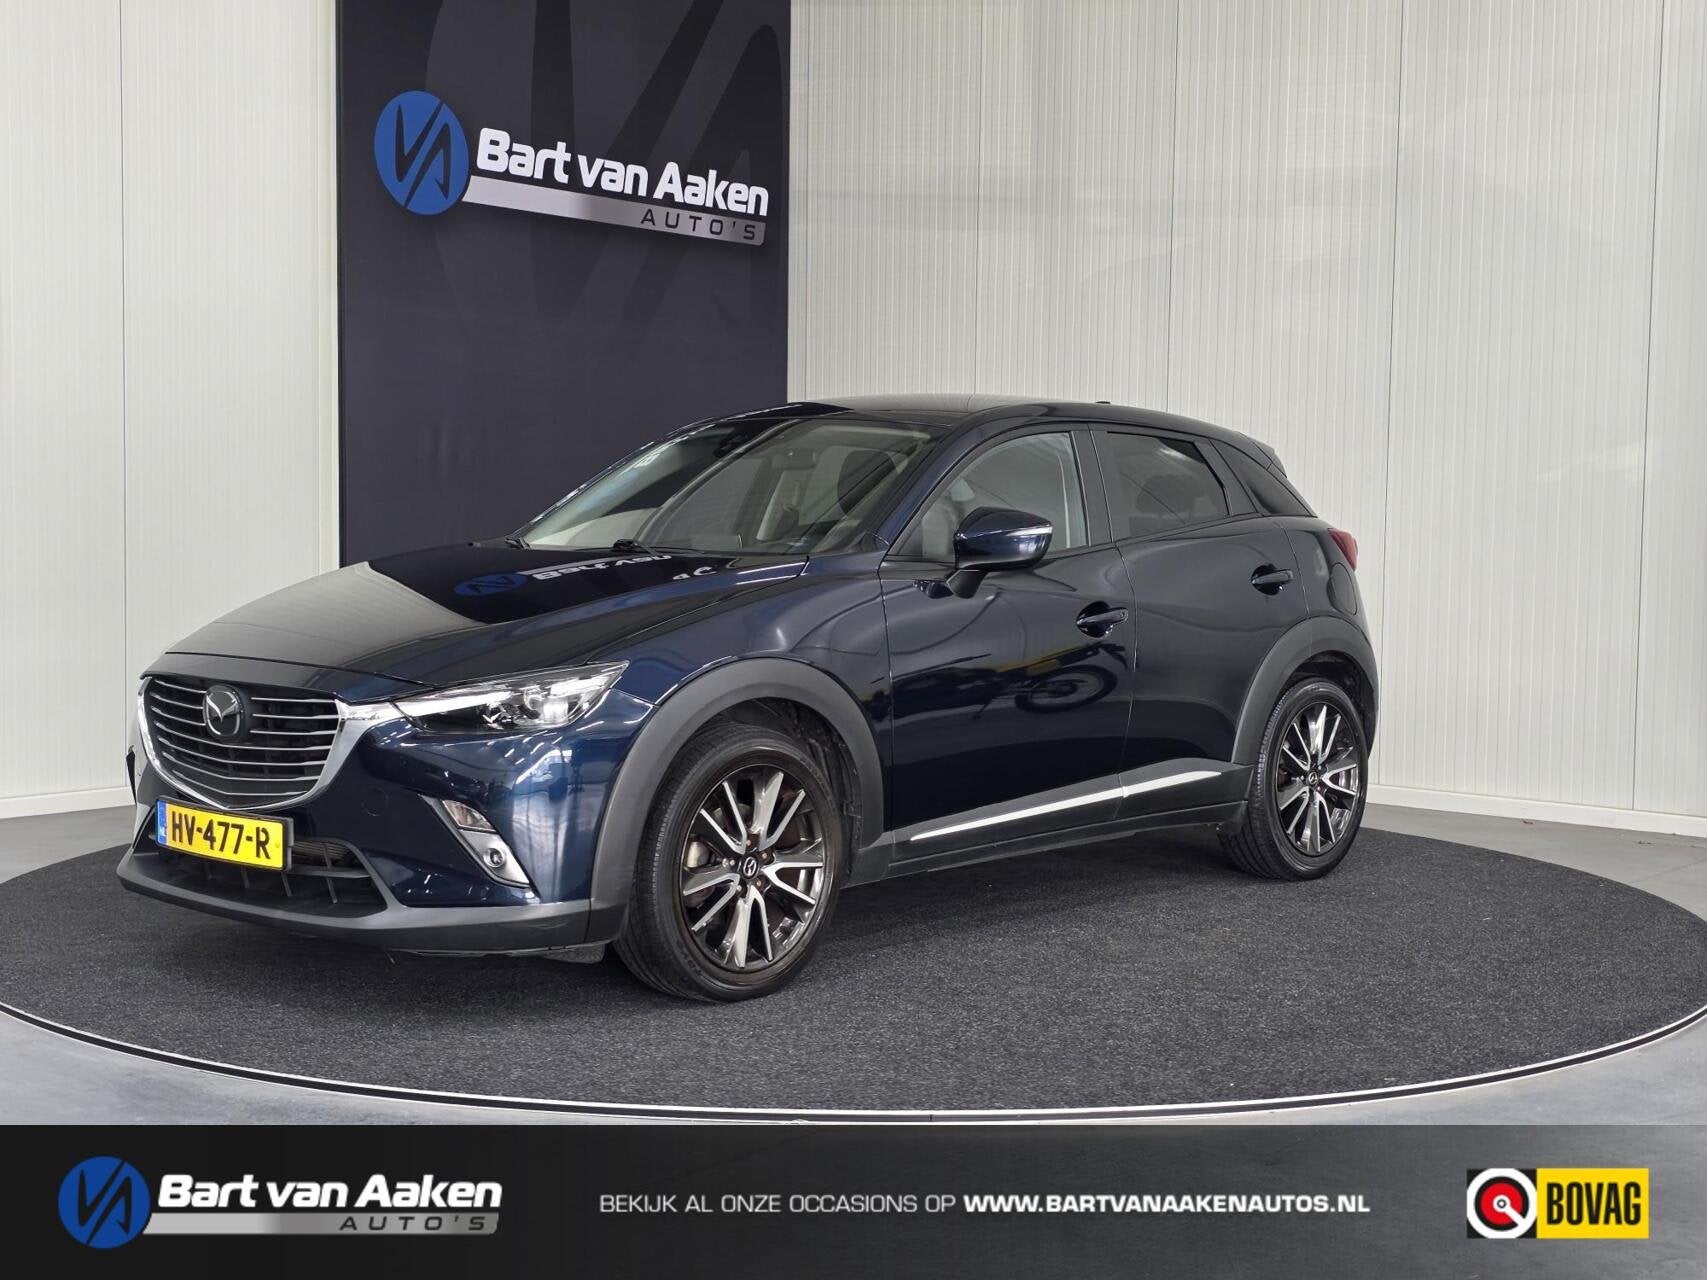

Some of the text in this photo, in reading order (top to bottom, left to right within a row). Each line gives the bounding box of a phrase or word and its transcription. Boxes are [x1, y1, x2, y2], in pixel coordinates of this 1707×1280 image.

[476, 127, 769, 217] Bart van Aaken
[640, 208, 756, 241] AUTO'S
[171, 811, 271, 860] HV-477-R
